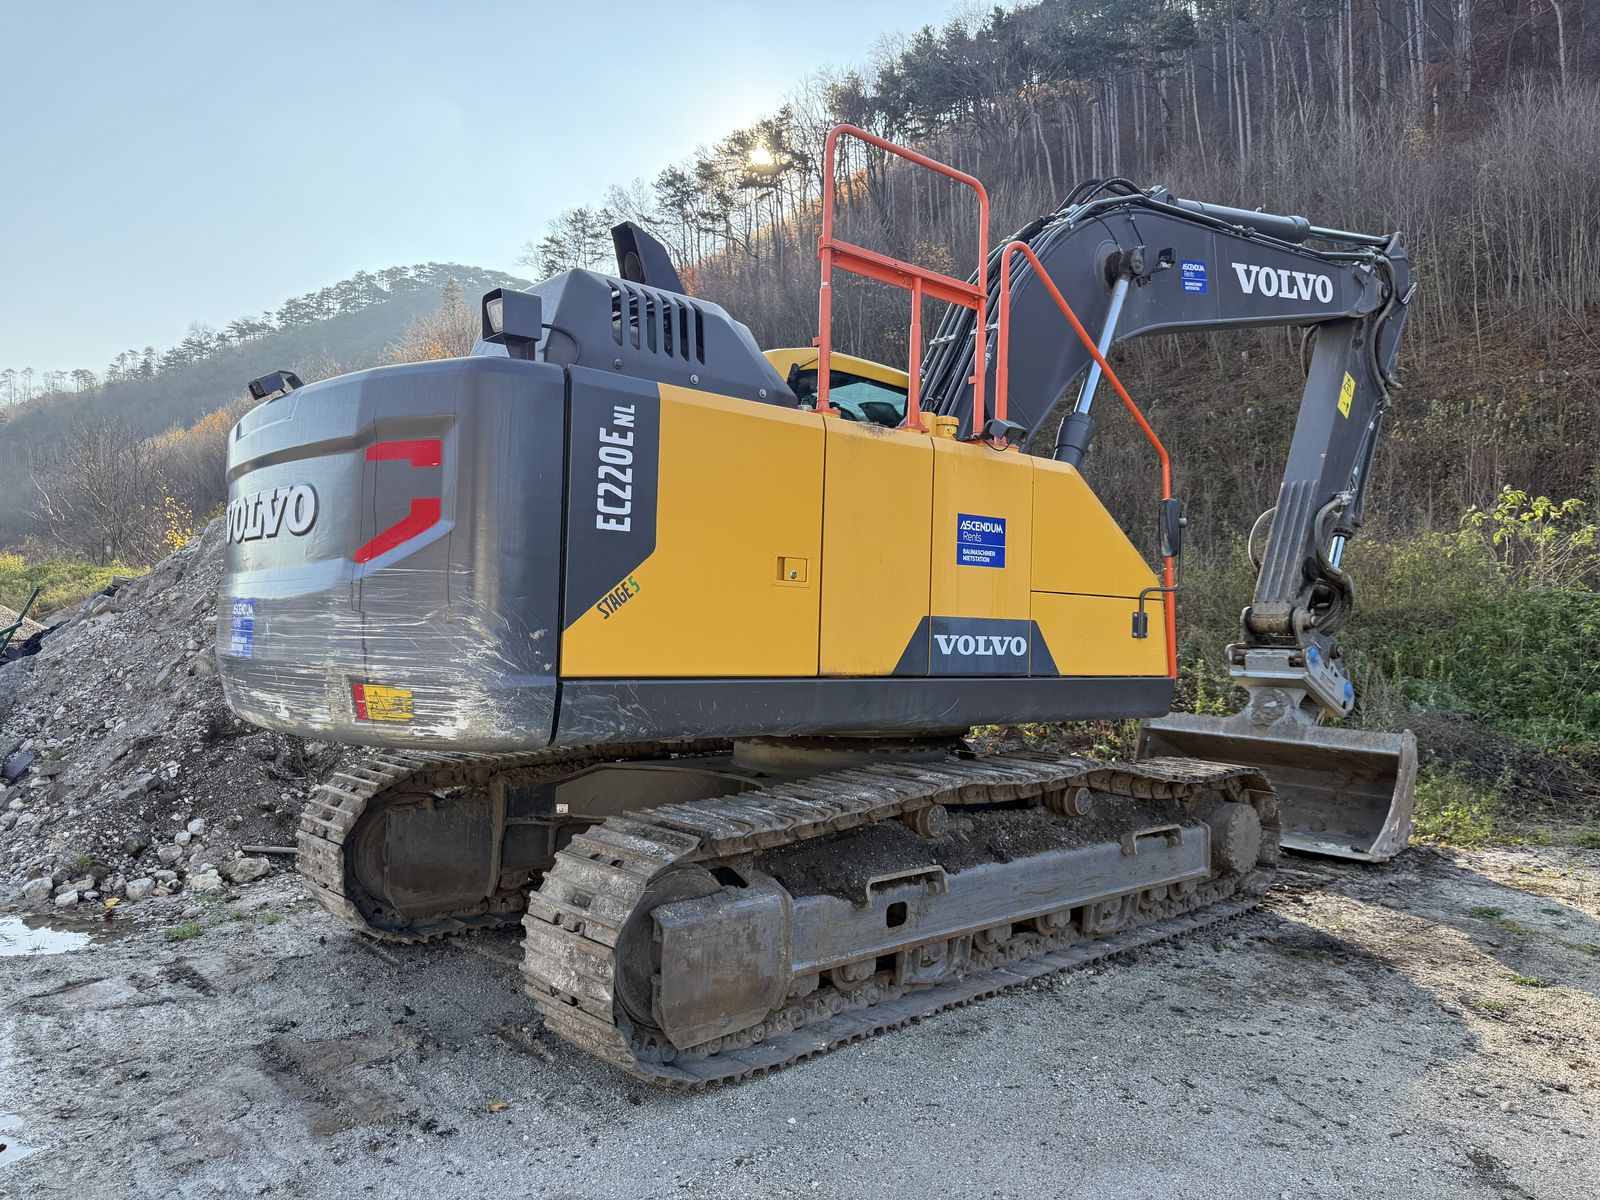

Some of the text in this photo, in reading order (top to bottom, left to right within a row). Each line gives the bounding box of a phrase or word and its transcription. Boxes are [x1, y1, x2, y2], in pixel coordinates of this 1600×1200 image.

[1231, 262, 1334, 304] VOLVO
[226, 483, 320, 545] VOLVO
[960, 520, 1004, 534] ASCENDUM
[962, 530, 982, 543] Rents
[933, 634, 1028, 657] VOLVO
